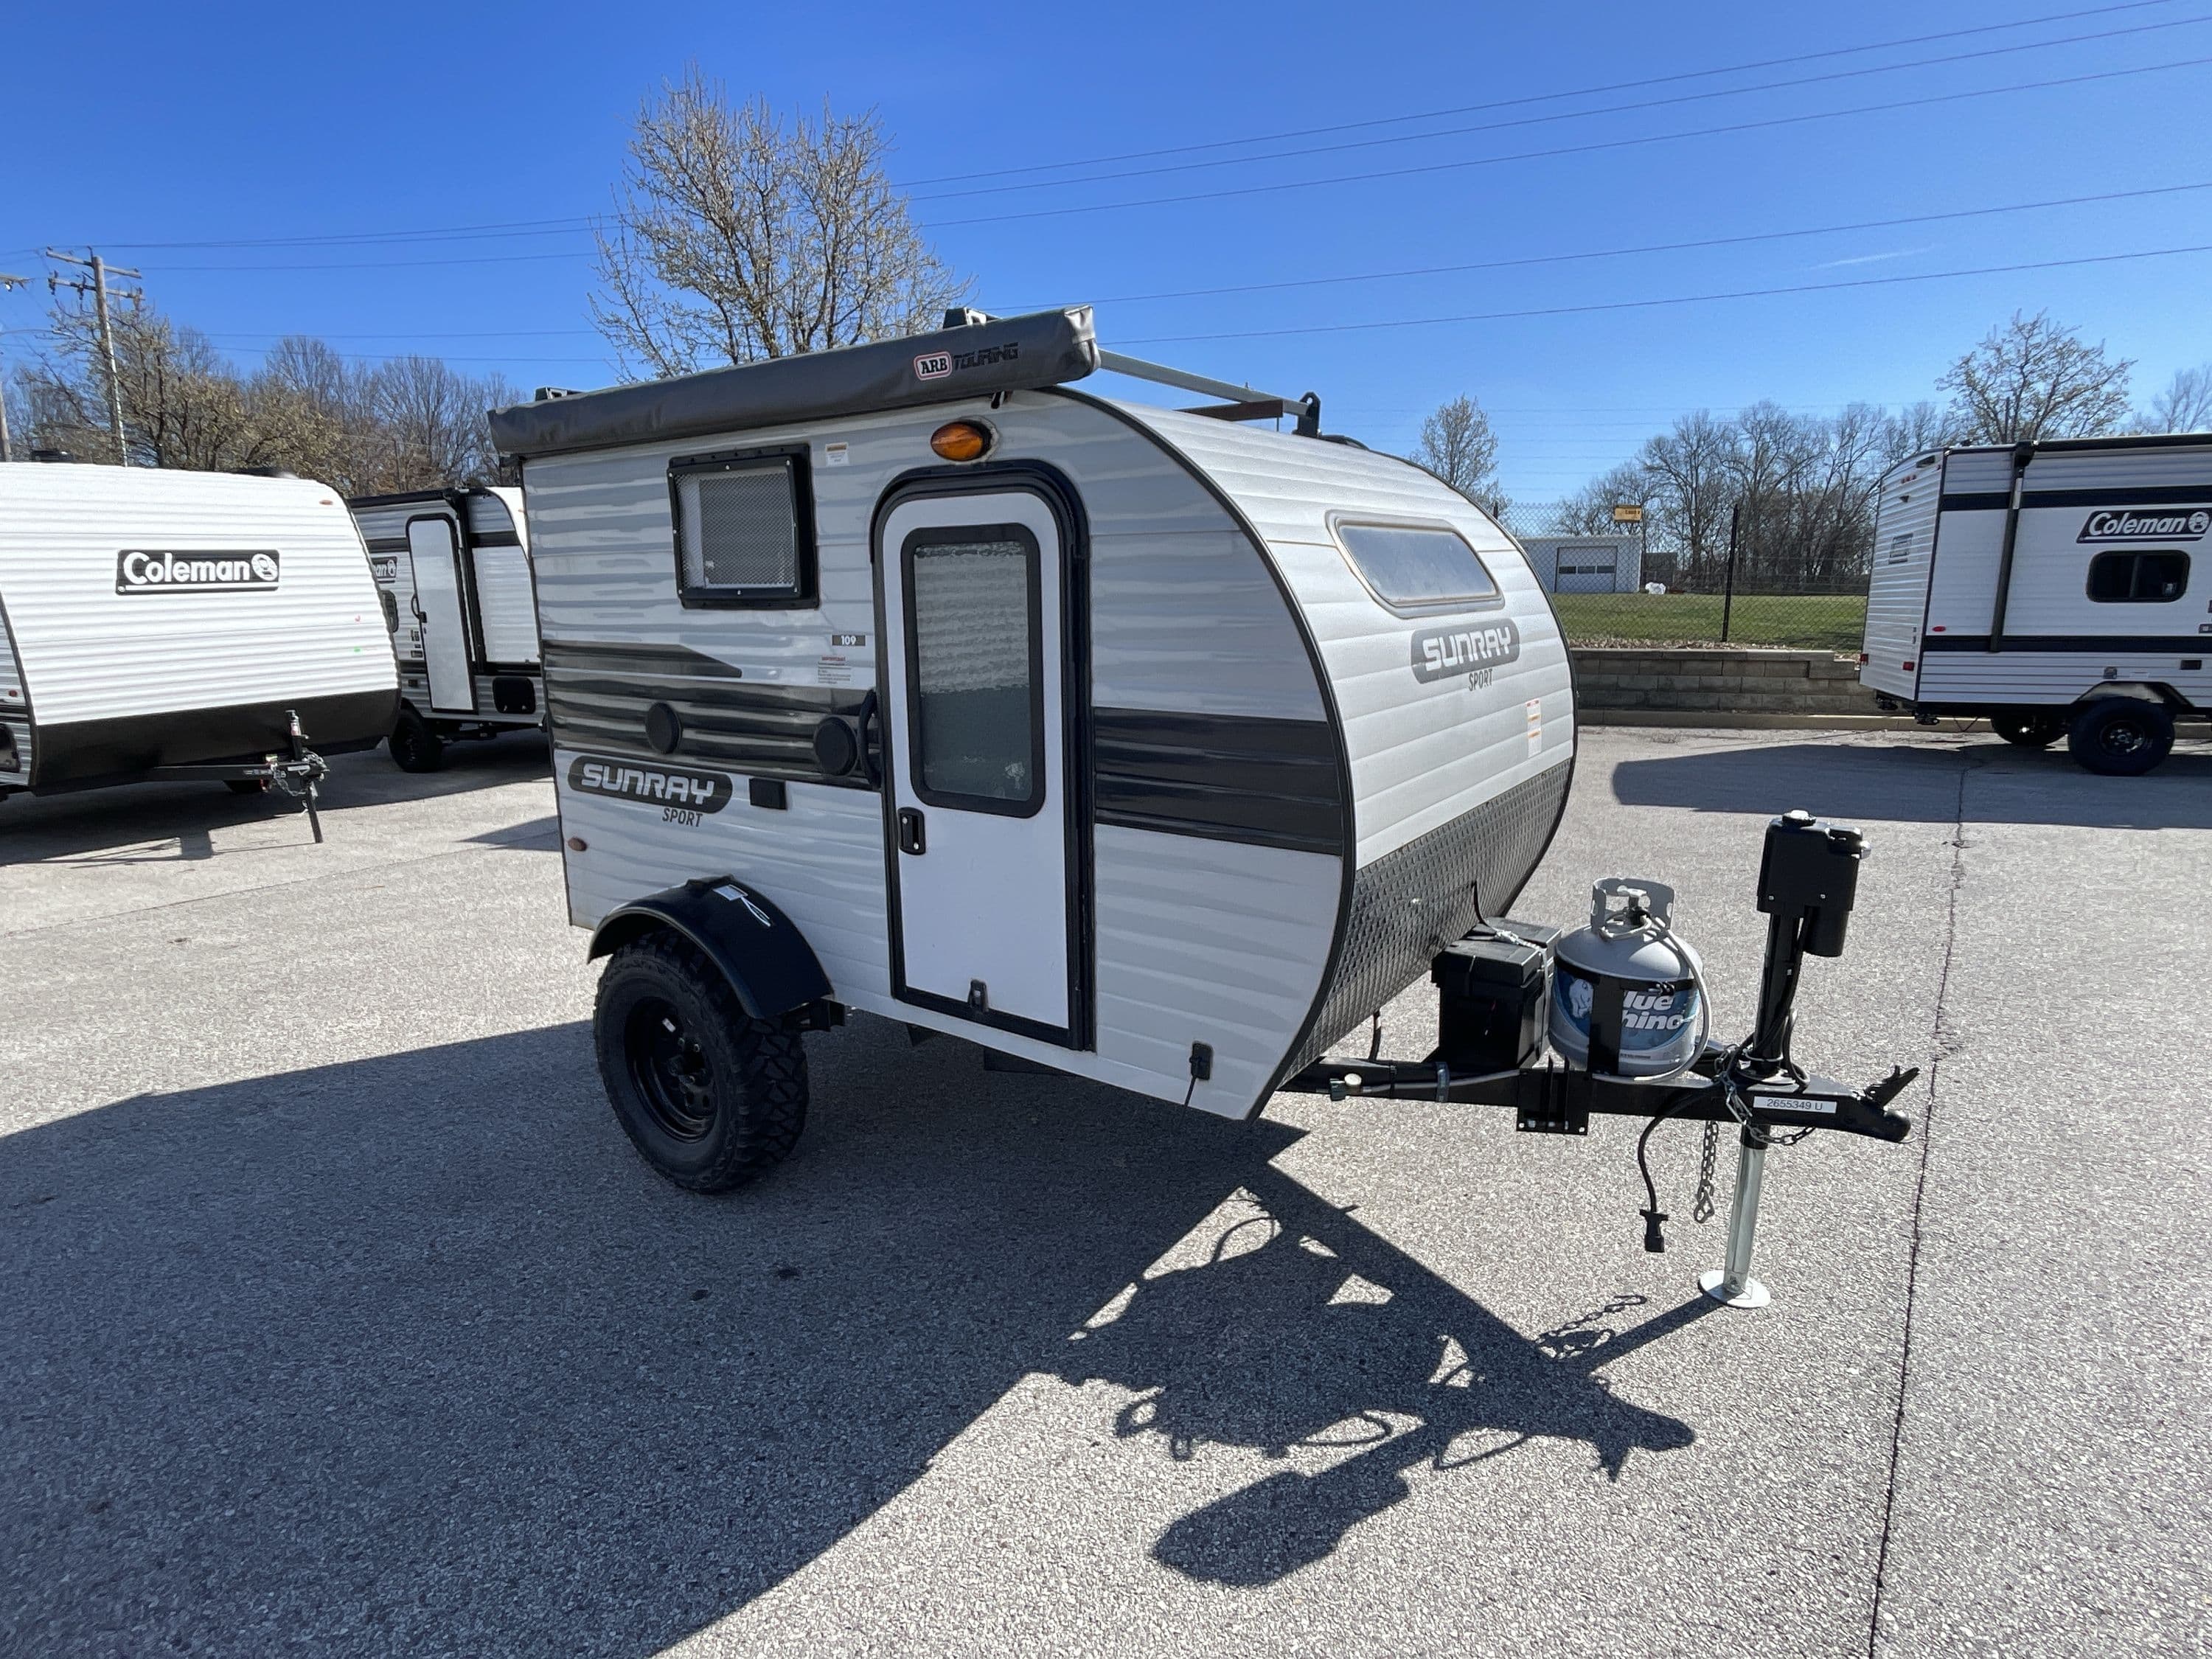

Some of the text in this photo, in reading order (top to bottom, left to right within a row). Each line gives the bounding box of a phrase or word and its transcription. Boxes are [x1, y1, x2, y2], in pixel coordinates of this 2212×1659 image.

[921, 342, 1019, 374] ARB TOURING
[2089, 512, 2186, 535] Coleman
[124, 552, 250, 585] Coleman
[841, 635, 856, 645] 109
[1422, 627, 1512, 672] SUNRAY
[1469, 669, 1493, 691] SPORT
[581, 763, 714, 804] SUNRAY
[662, 808, 703, 827] SPORT
[1623, 991, 1674, 1011] lue
[1622, 1010, 1684, 1030] hino
[1767, 1099, 1823, 1110] 2655349 U
